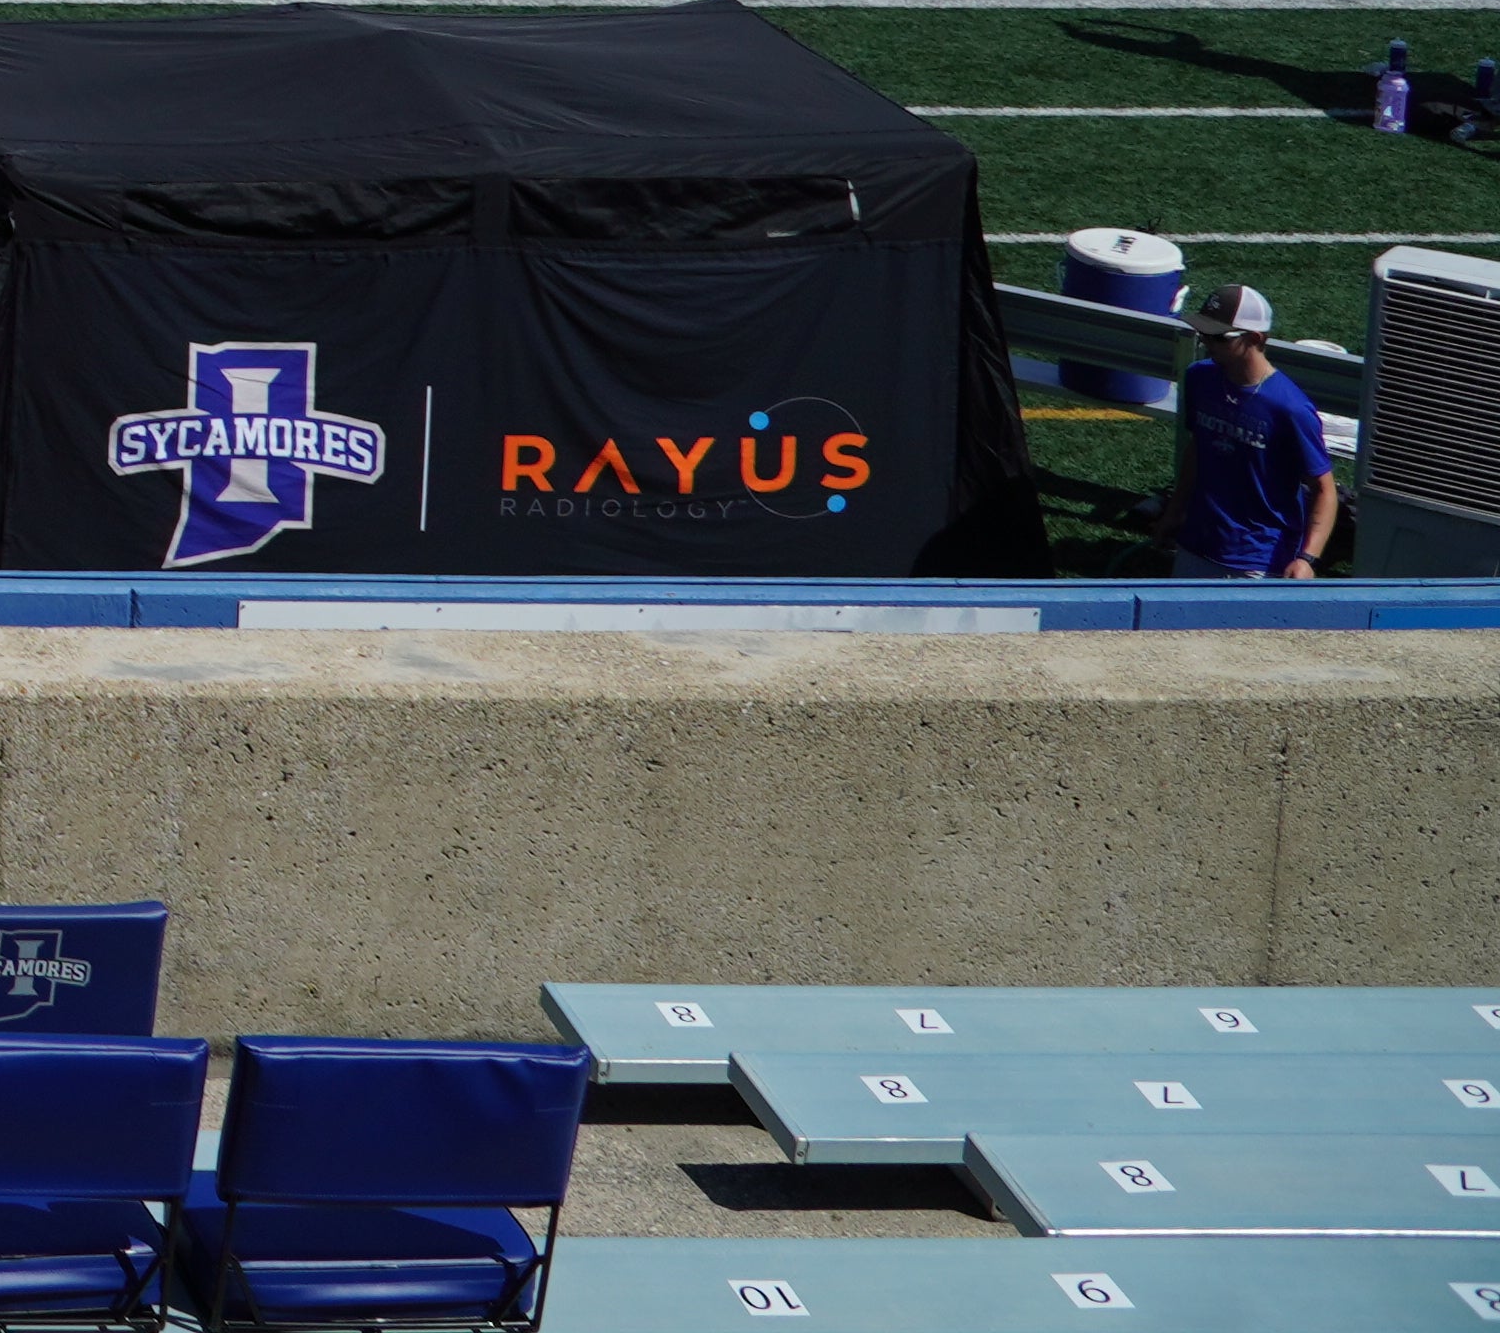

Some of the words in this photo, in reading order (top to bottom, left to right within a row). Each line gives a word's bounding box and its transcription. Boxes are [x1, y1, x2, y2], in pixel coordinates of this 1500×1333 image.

[120, 414, 375, 474] SYCAMORES
[501, 434, 871, 493] RAYUS
[500, 497, 730, 518] RADIOLOGY
[671, 1006, 696, 1022] 8
[879, 1079, 908, 1099] 8
[1120, 1165, 1154, 1187] 8
[740, 1286, 801, 1311] 10
